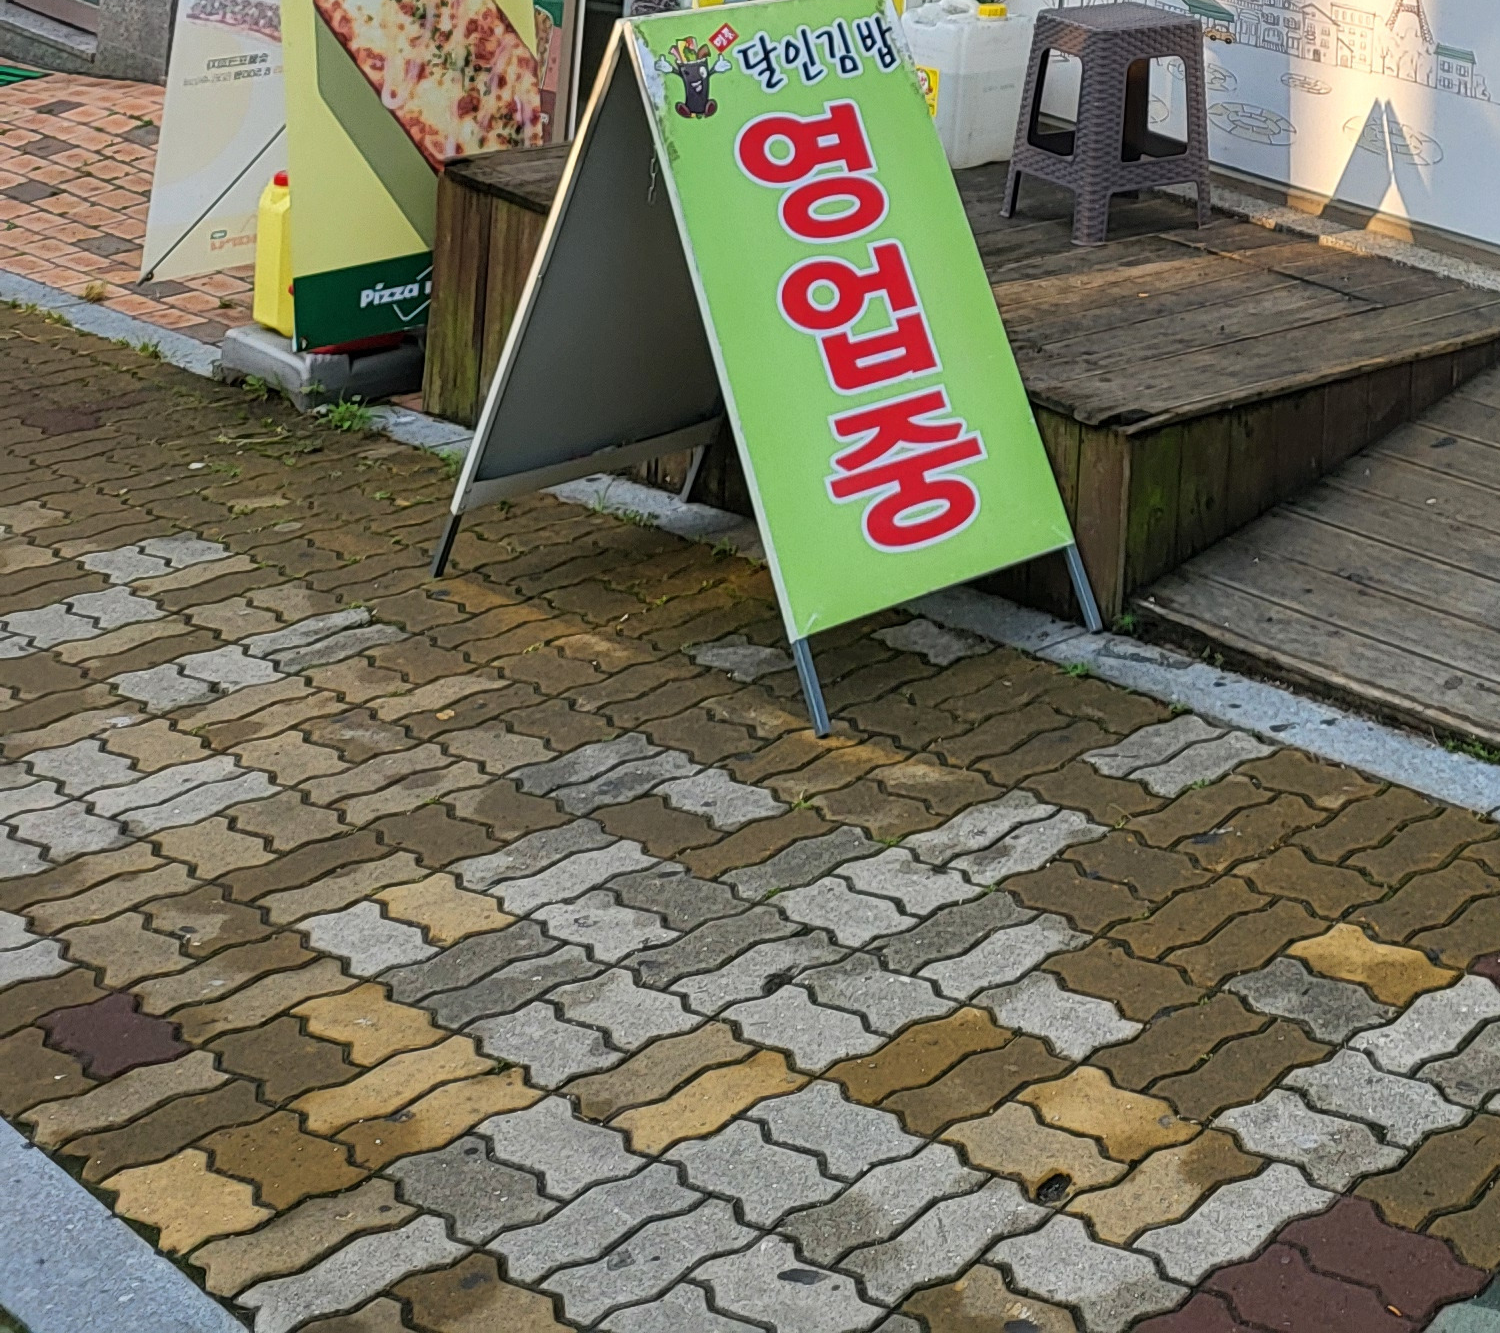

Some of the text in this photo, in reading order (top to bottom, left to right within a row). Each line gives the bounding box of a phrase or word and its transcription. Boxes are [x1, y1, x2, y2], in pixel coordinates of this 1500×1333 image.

[737, 15, 898, 90] 달인김밥
[360, 281, 420, 309] Pizza
[737, 102, 985, 550] 영업중
